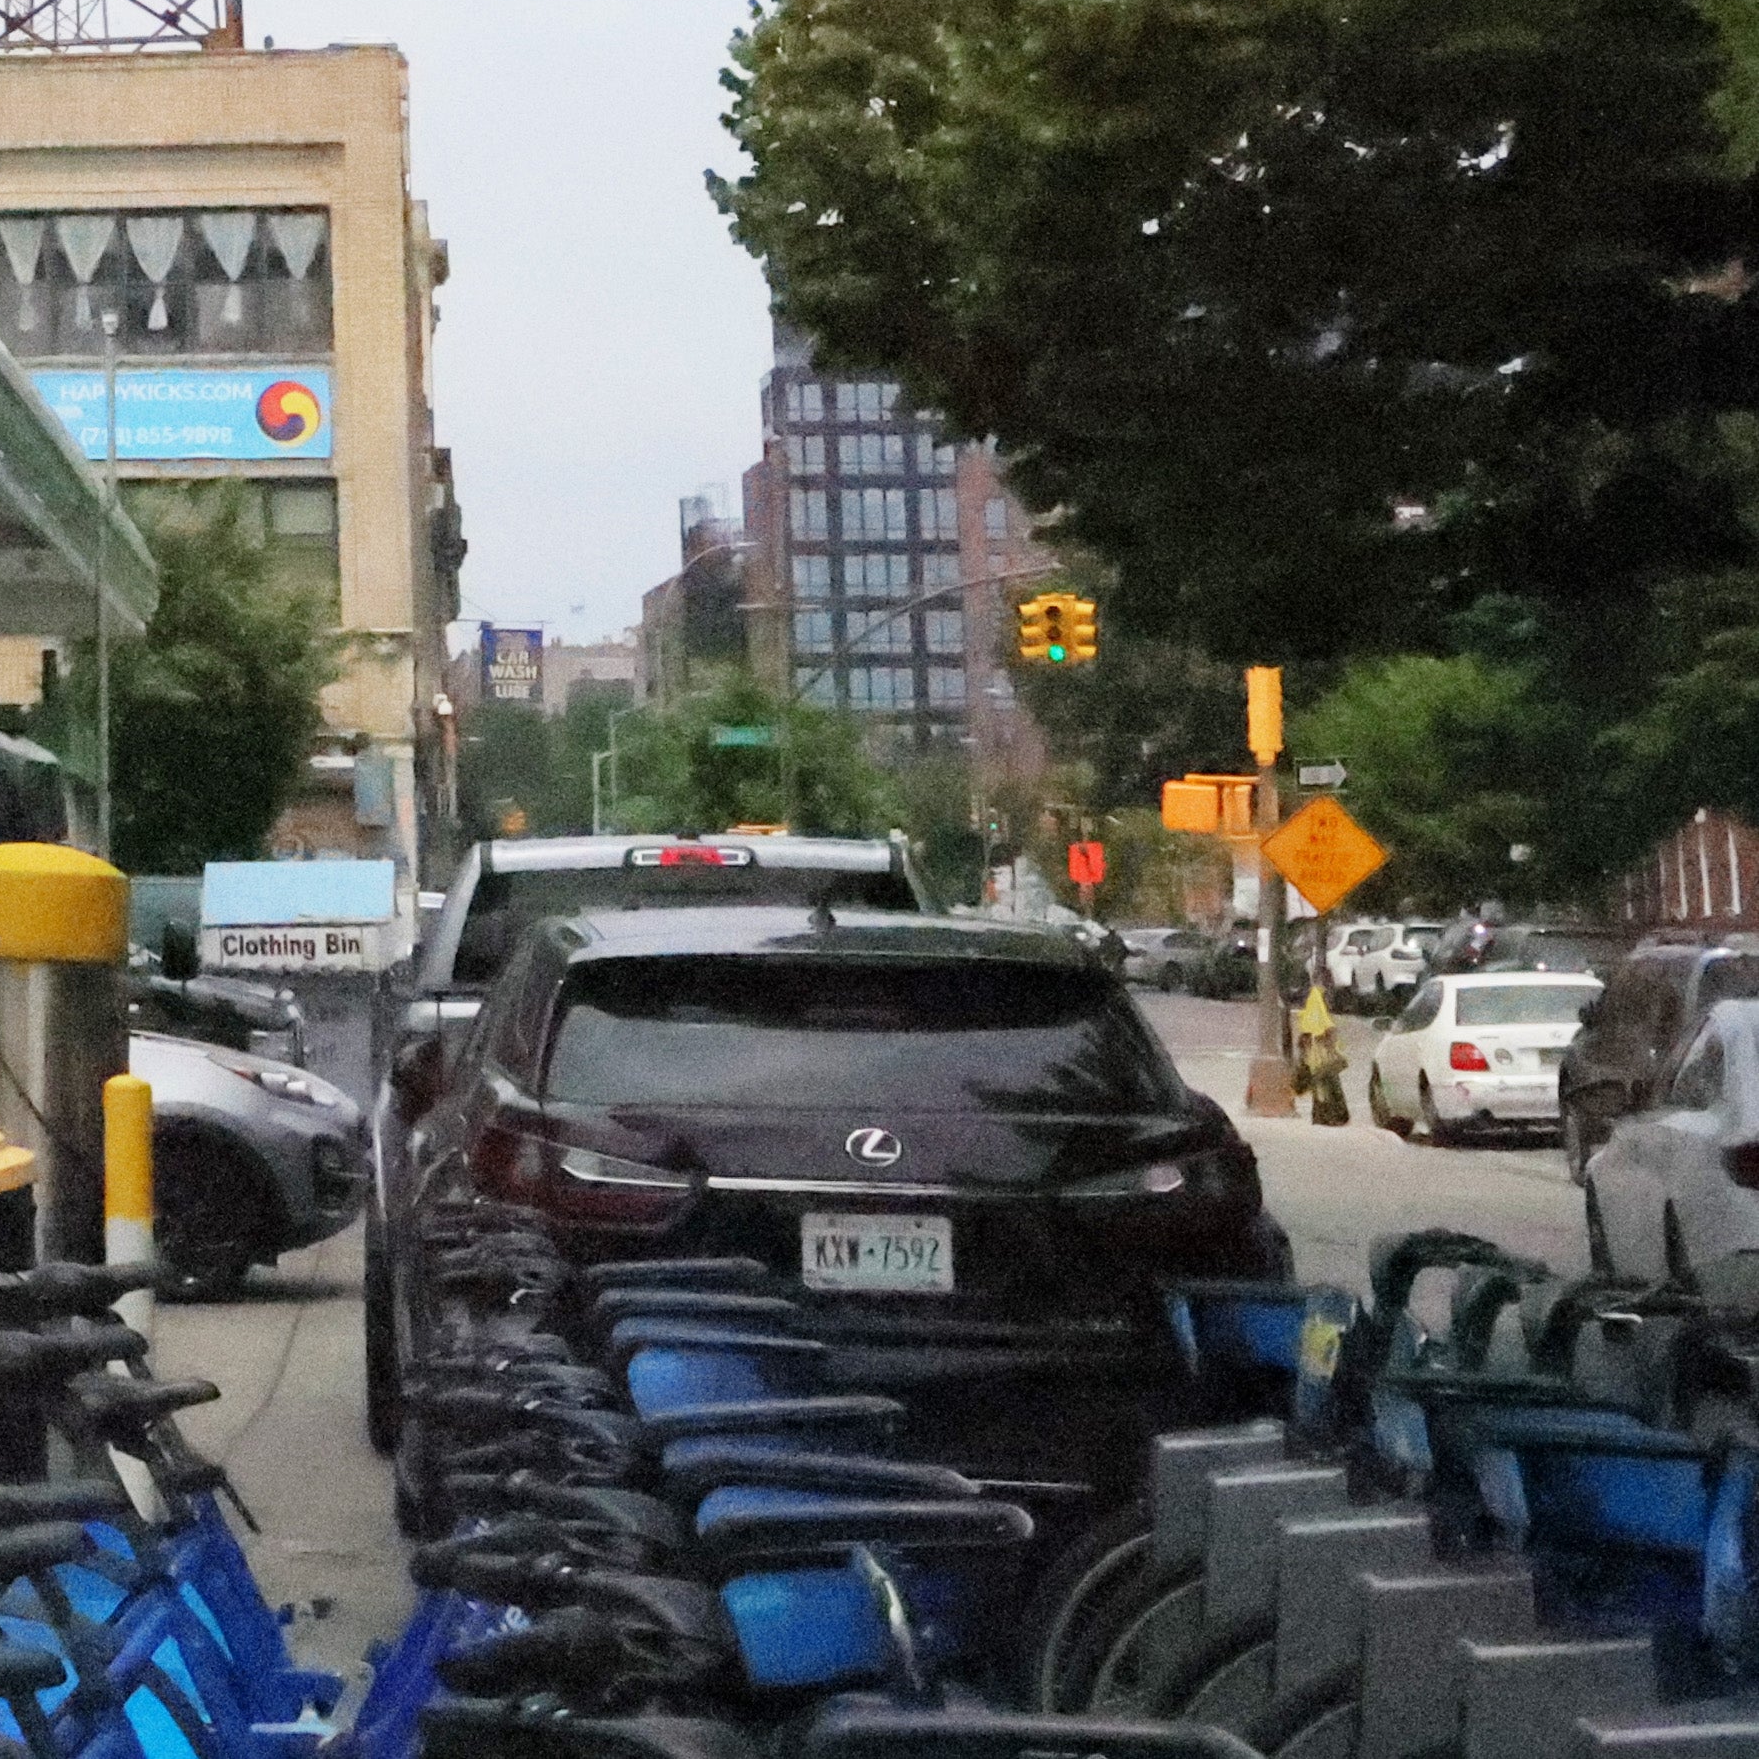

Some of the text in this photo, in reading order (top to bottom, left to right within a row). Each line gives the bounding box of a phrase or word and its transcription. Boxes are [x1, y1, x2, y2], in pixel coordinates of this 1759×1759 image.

[60, 383, 253, 402] HAPYKICKS.COM
[488, 664, 538, 679] WASH
[222, 932, 361, 961] Clothing Bin
